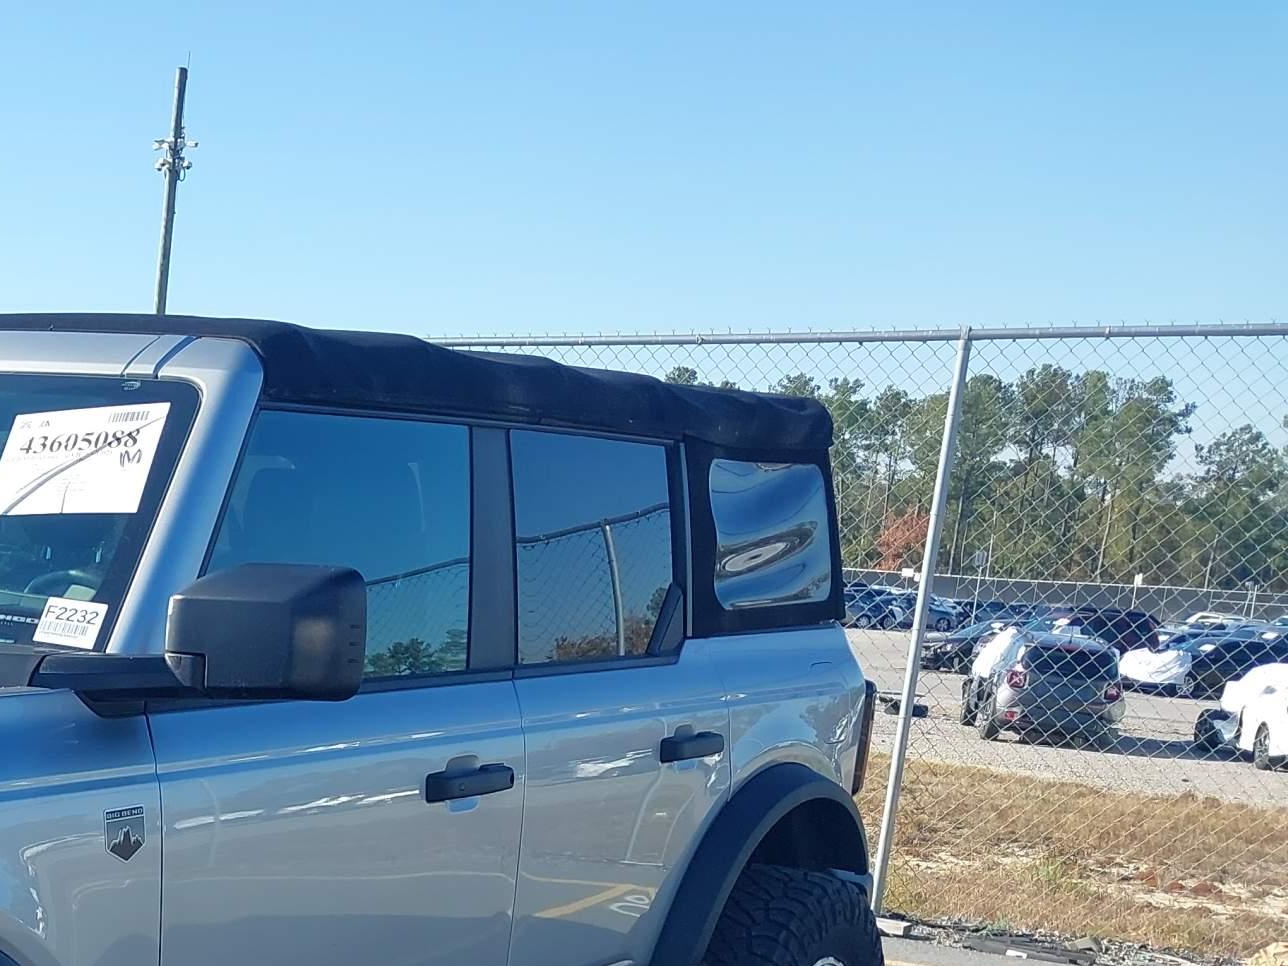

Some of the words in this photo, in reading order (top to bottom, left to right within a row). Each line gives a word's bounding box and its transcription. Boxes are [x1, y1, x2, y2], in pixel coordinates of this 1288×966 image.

[20, 428, 141, 454] 43605088
[44, 604, 99, 625] F2232
[106, 811, 120, 819] BIG
[121, 807, 143, 817] BEND
